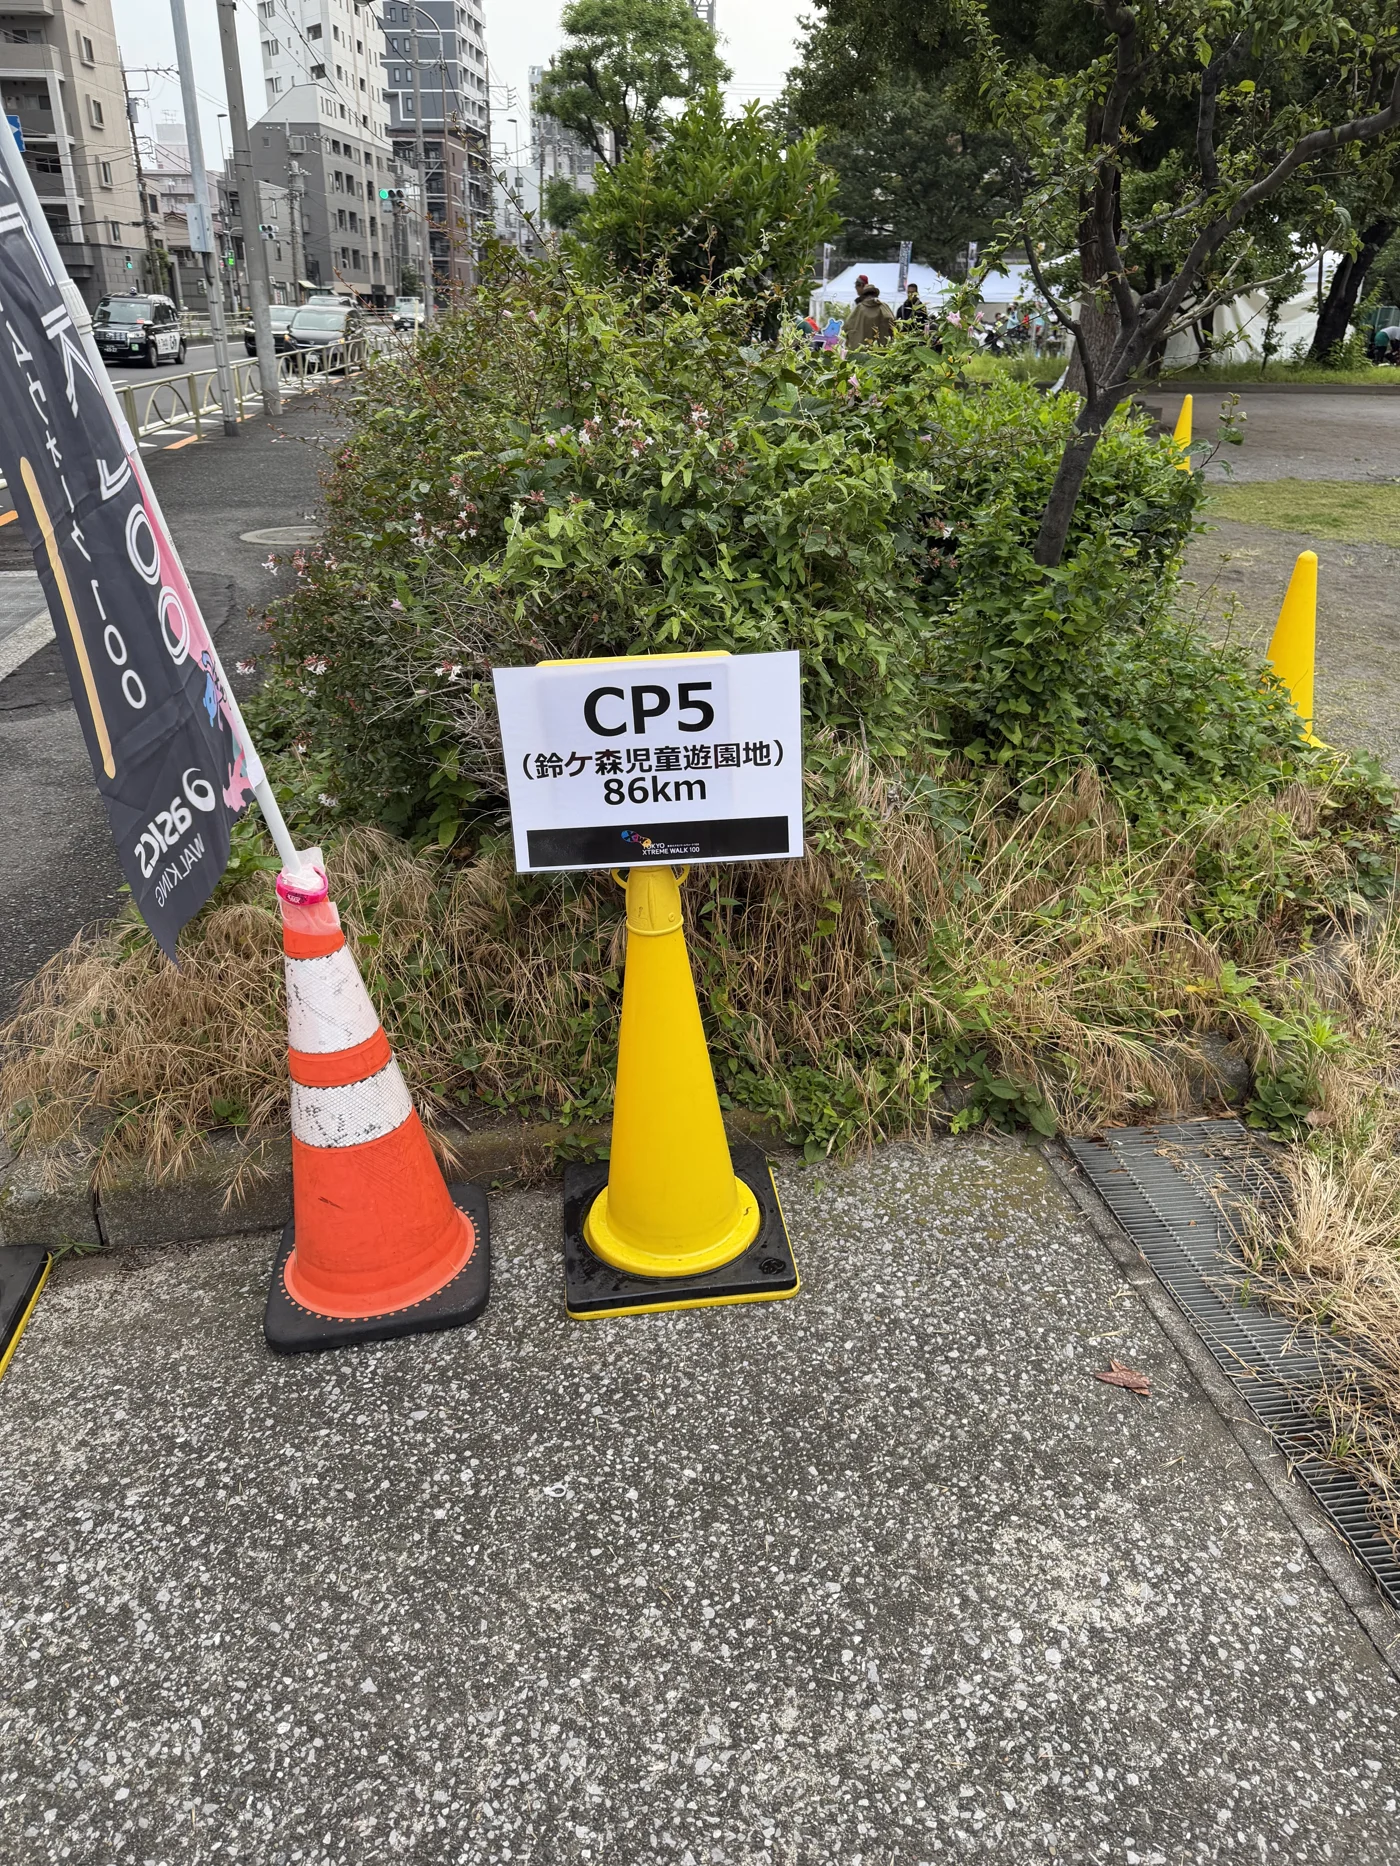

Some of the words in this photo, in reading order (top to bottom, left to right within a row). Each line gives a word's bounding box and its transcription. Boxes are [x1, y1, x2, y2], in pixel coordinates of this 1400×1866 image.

[583, 681, 715, 737] CP5
[603, 775, 707, 806] 86km
[642, 842, 665, 850] TOKYO
[642, 848, 669, 856] XTREME
